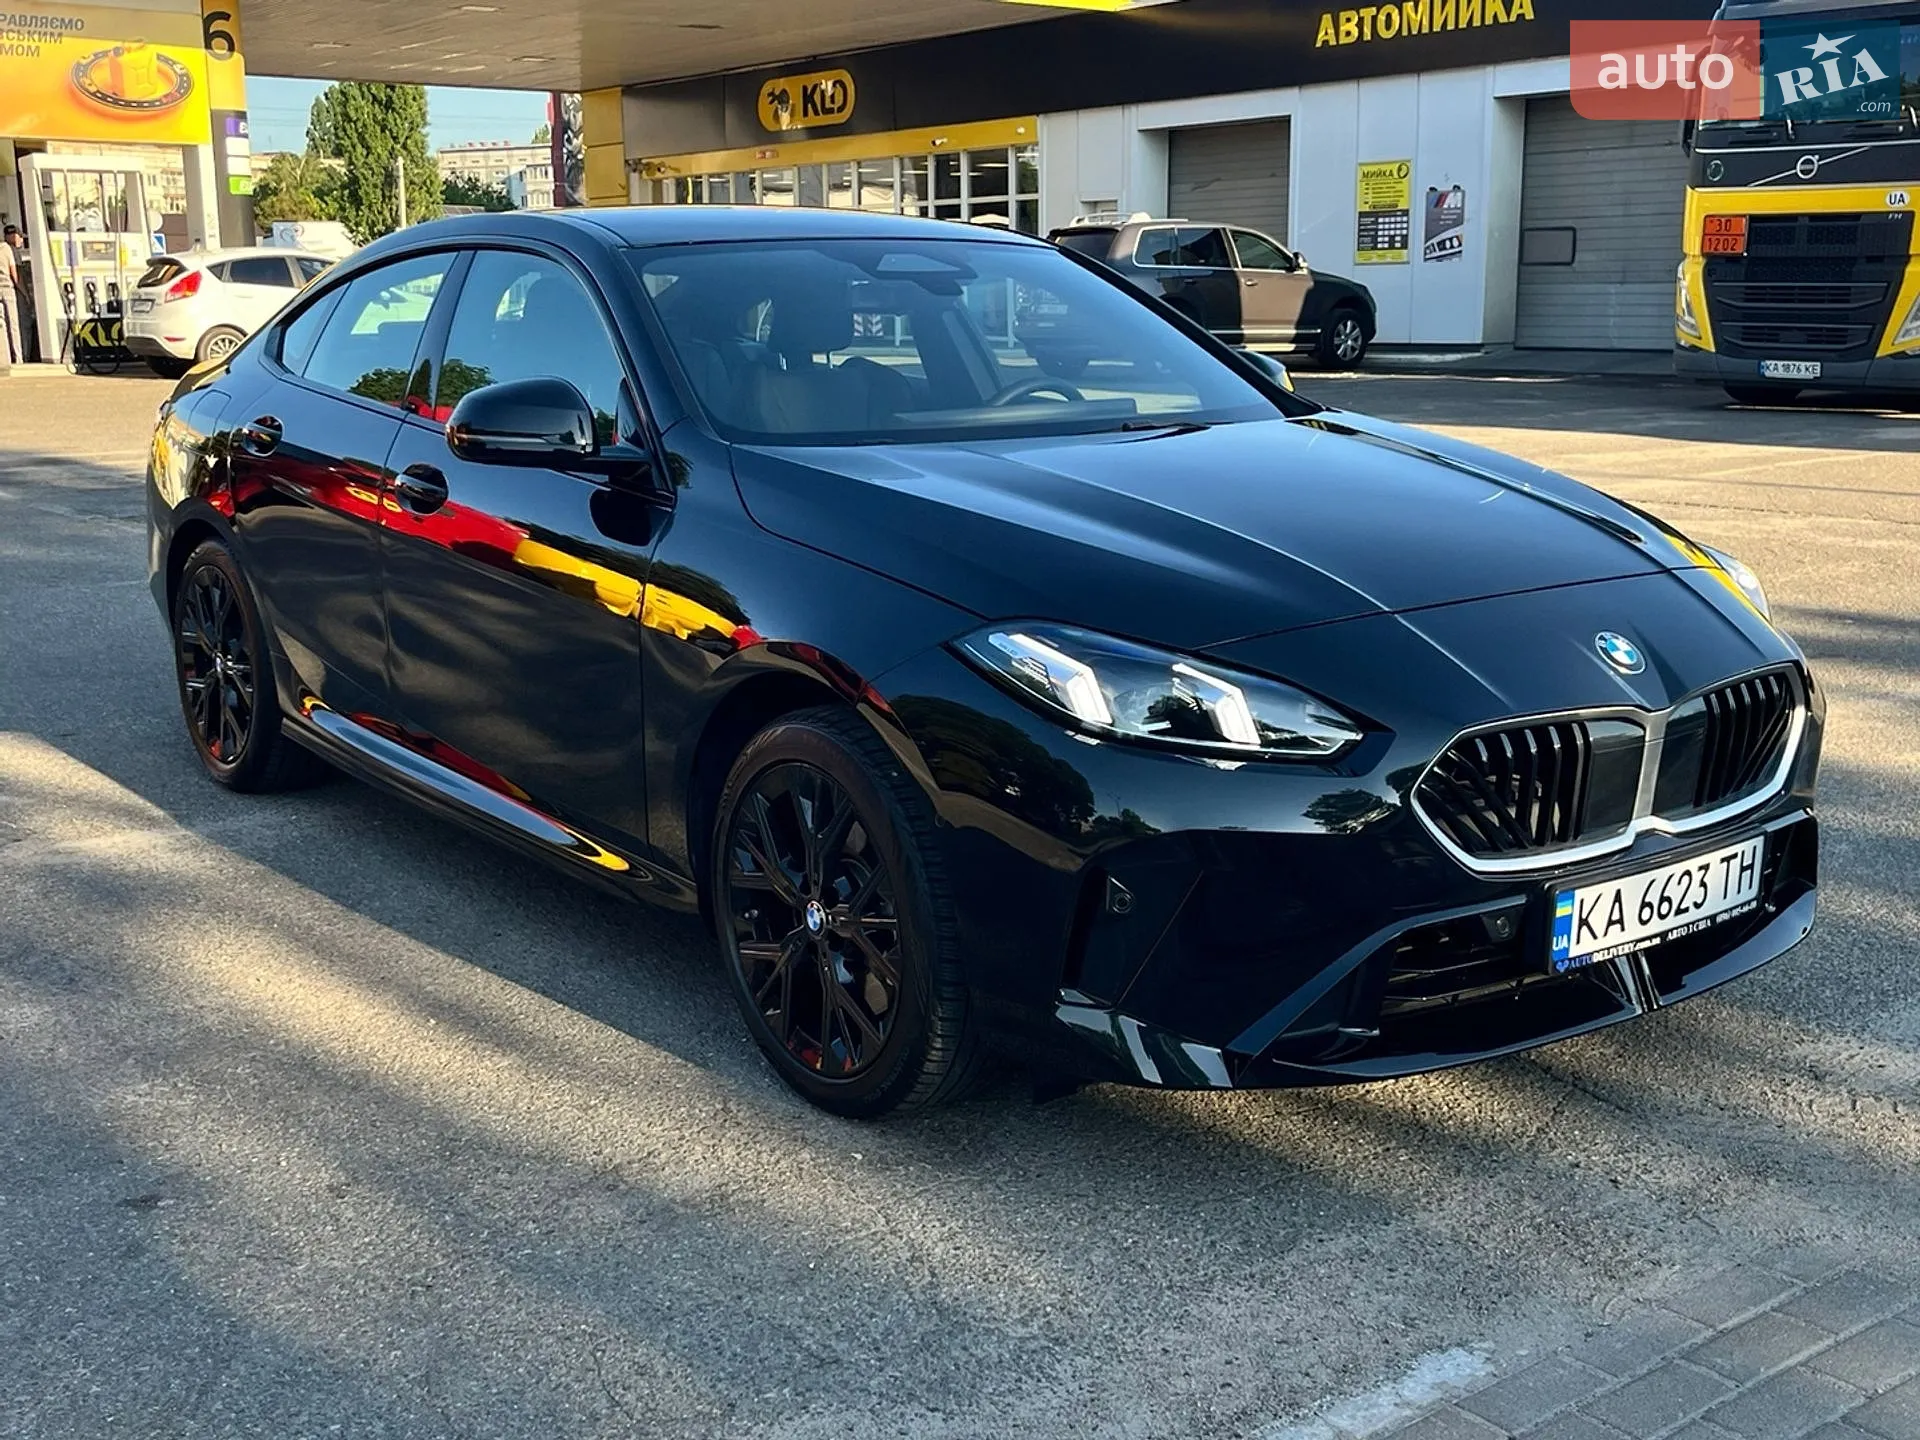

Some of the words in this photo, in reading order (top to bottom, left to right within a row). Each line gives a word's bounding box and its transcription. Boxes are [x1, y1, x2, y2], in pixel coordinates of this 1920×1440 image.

[203, 11, 235, 61] 6
[1889, 193, 1906, 205] UA
[1715, 218, 1732, 233] 30
[1707, 237, 1739, 252] 1202
[1576, 888, 1626, 945] KA
[1637, 862, 1711, 927] 6623
[1719, 845, 1758, 900] TH
[1552, 934, 1568, 951] UA
